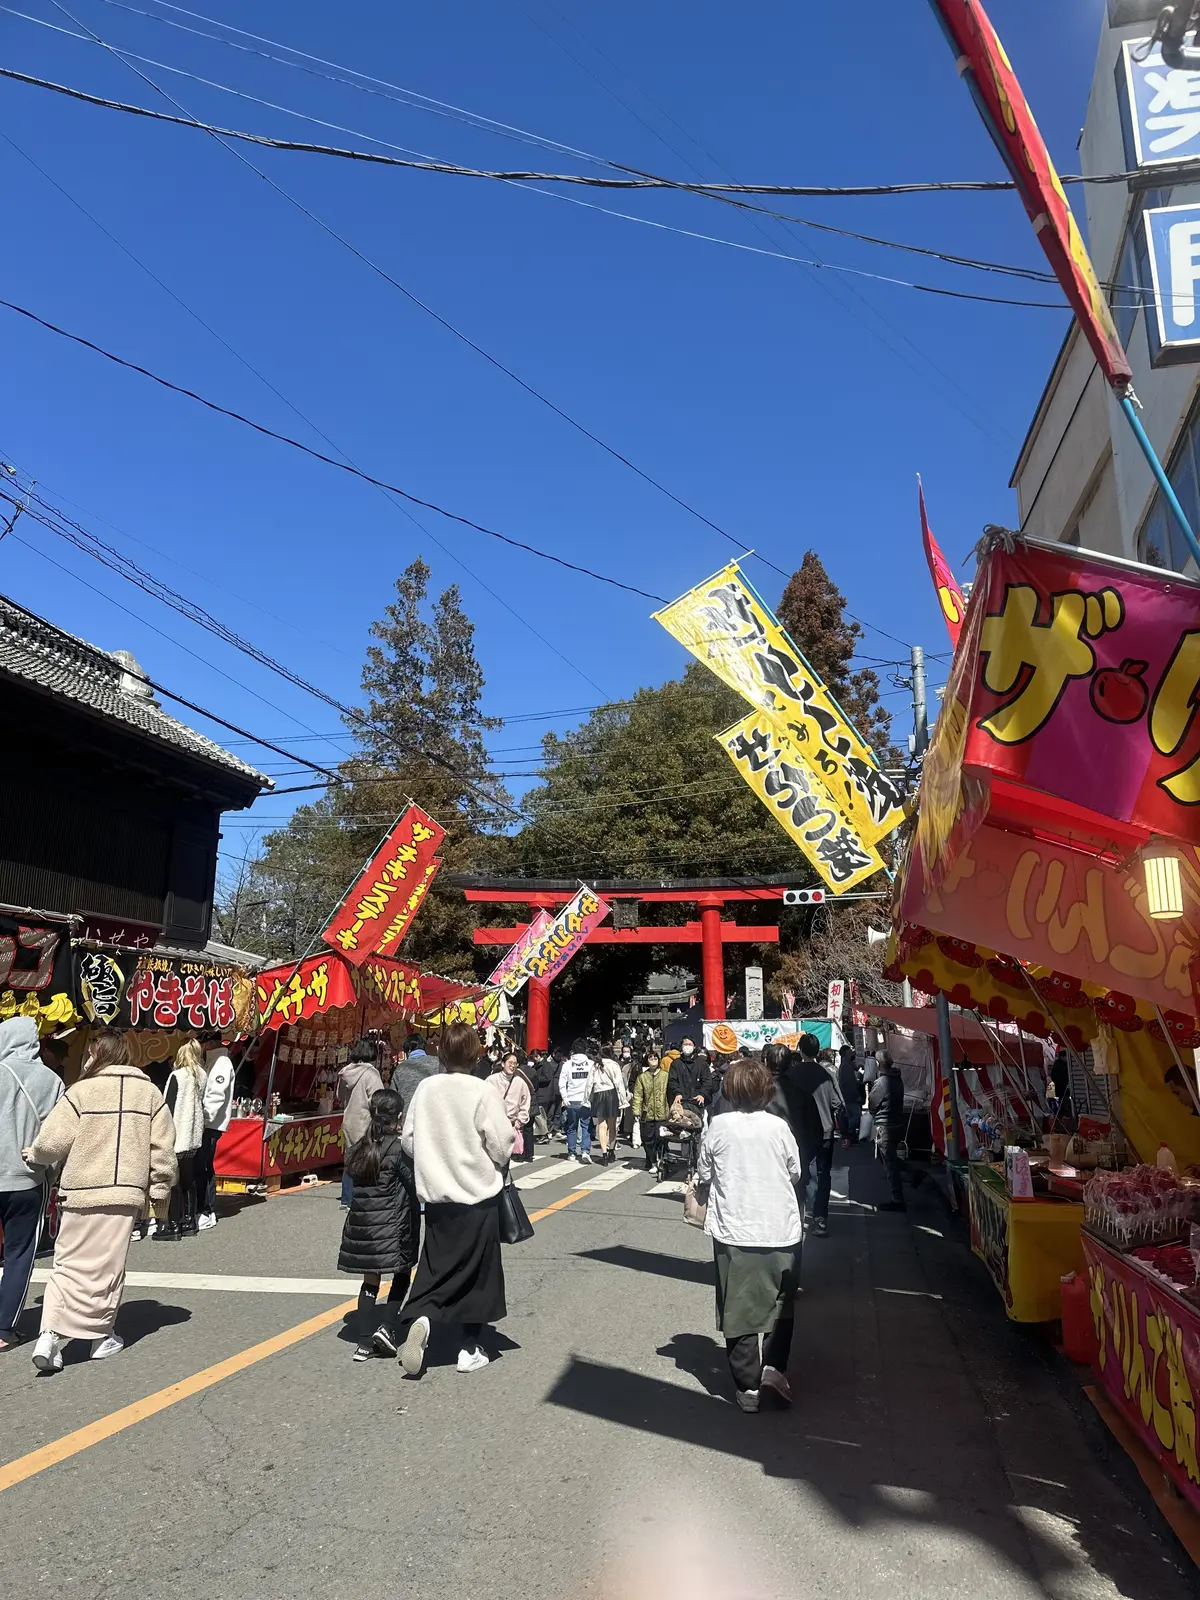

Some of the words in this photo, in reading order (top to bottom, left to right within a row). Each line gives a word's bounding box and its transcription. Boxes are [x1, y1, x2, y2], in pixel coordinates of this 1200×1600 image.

[336, 820, 436, 951] ザ・チキンステーキ
